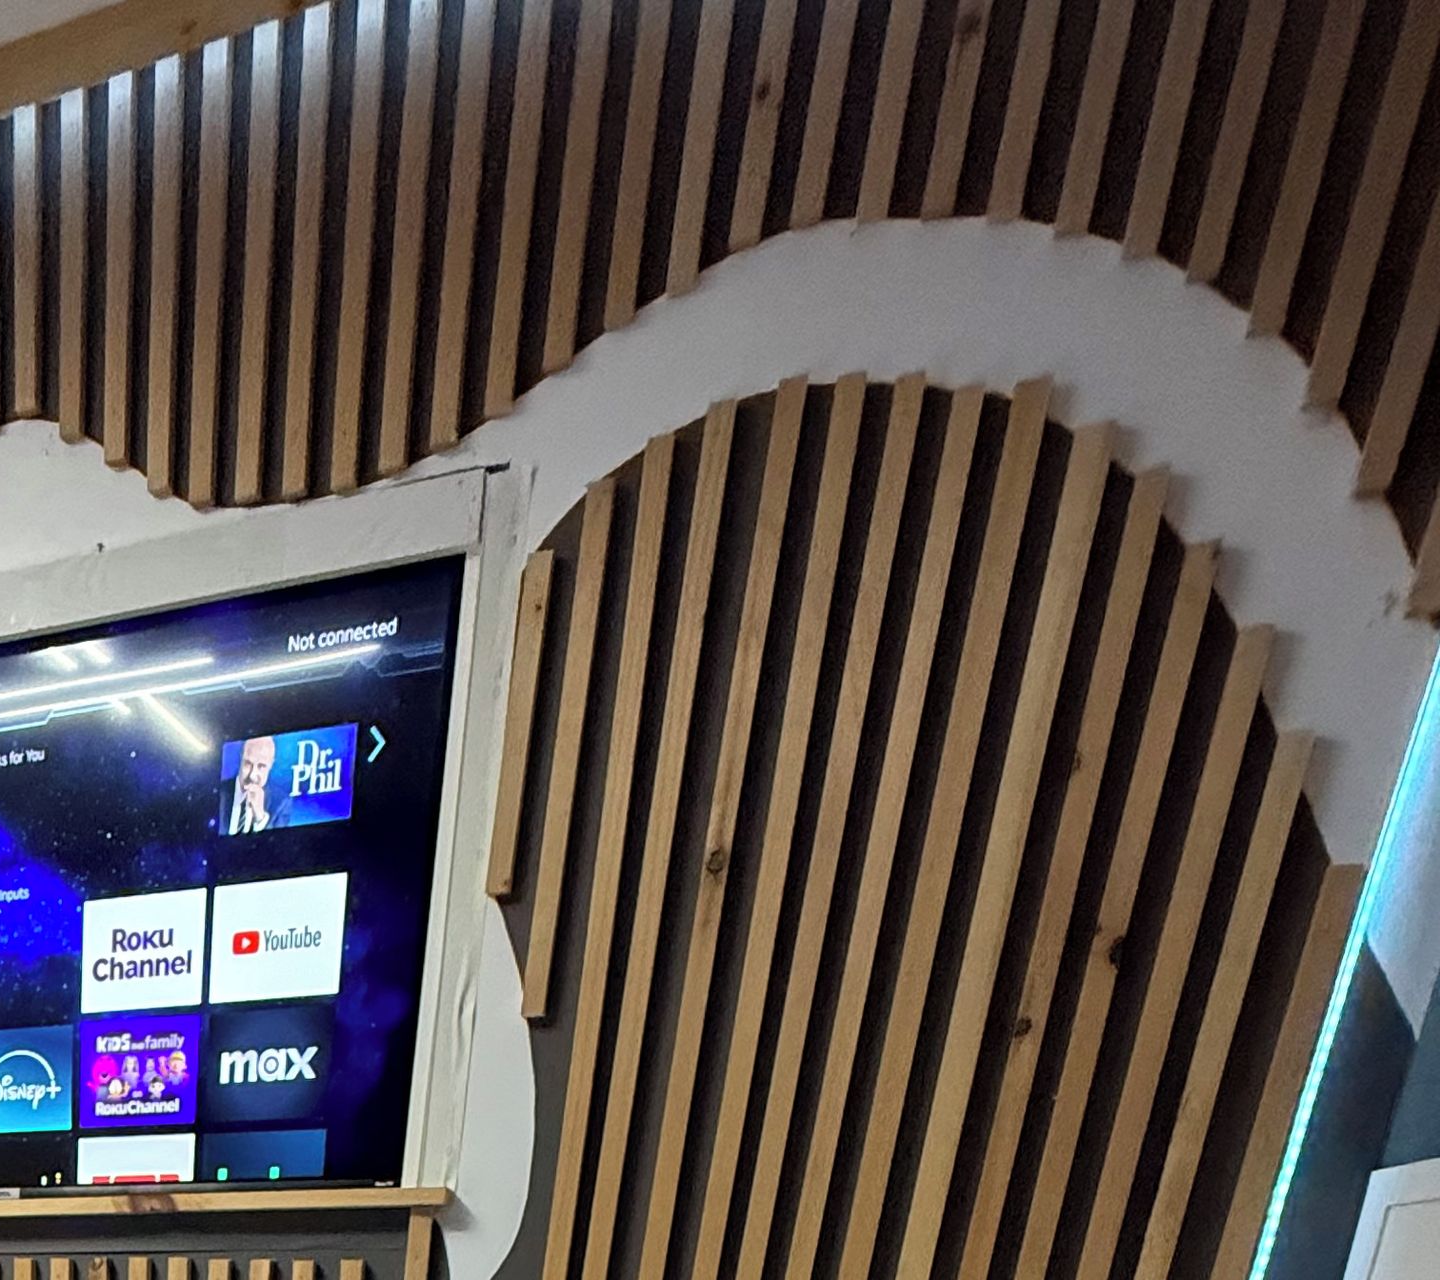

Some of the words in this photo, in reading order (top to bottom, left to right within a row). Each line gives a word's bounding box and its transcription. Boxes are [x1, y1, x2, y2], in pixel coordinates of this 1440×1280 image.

[288, 633, 315, 652] Not
[318, 616, 398, 648] connected
[9, 750, 24, 765] for
[25, 748, 45, 762] You
[297, 740, 334, 772] Dr.
[289, 759, 342, 797] Phil
[263, 925, 322, 952] YouTube
[92, 950, 193, 982] Channel
[219, 1046, 319, 1085] max
